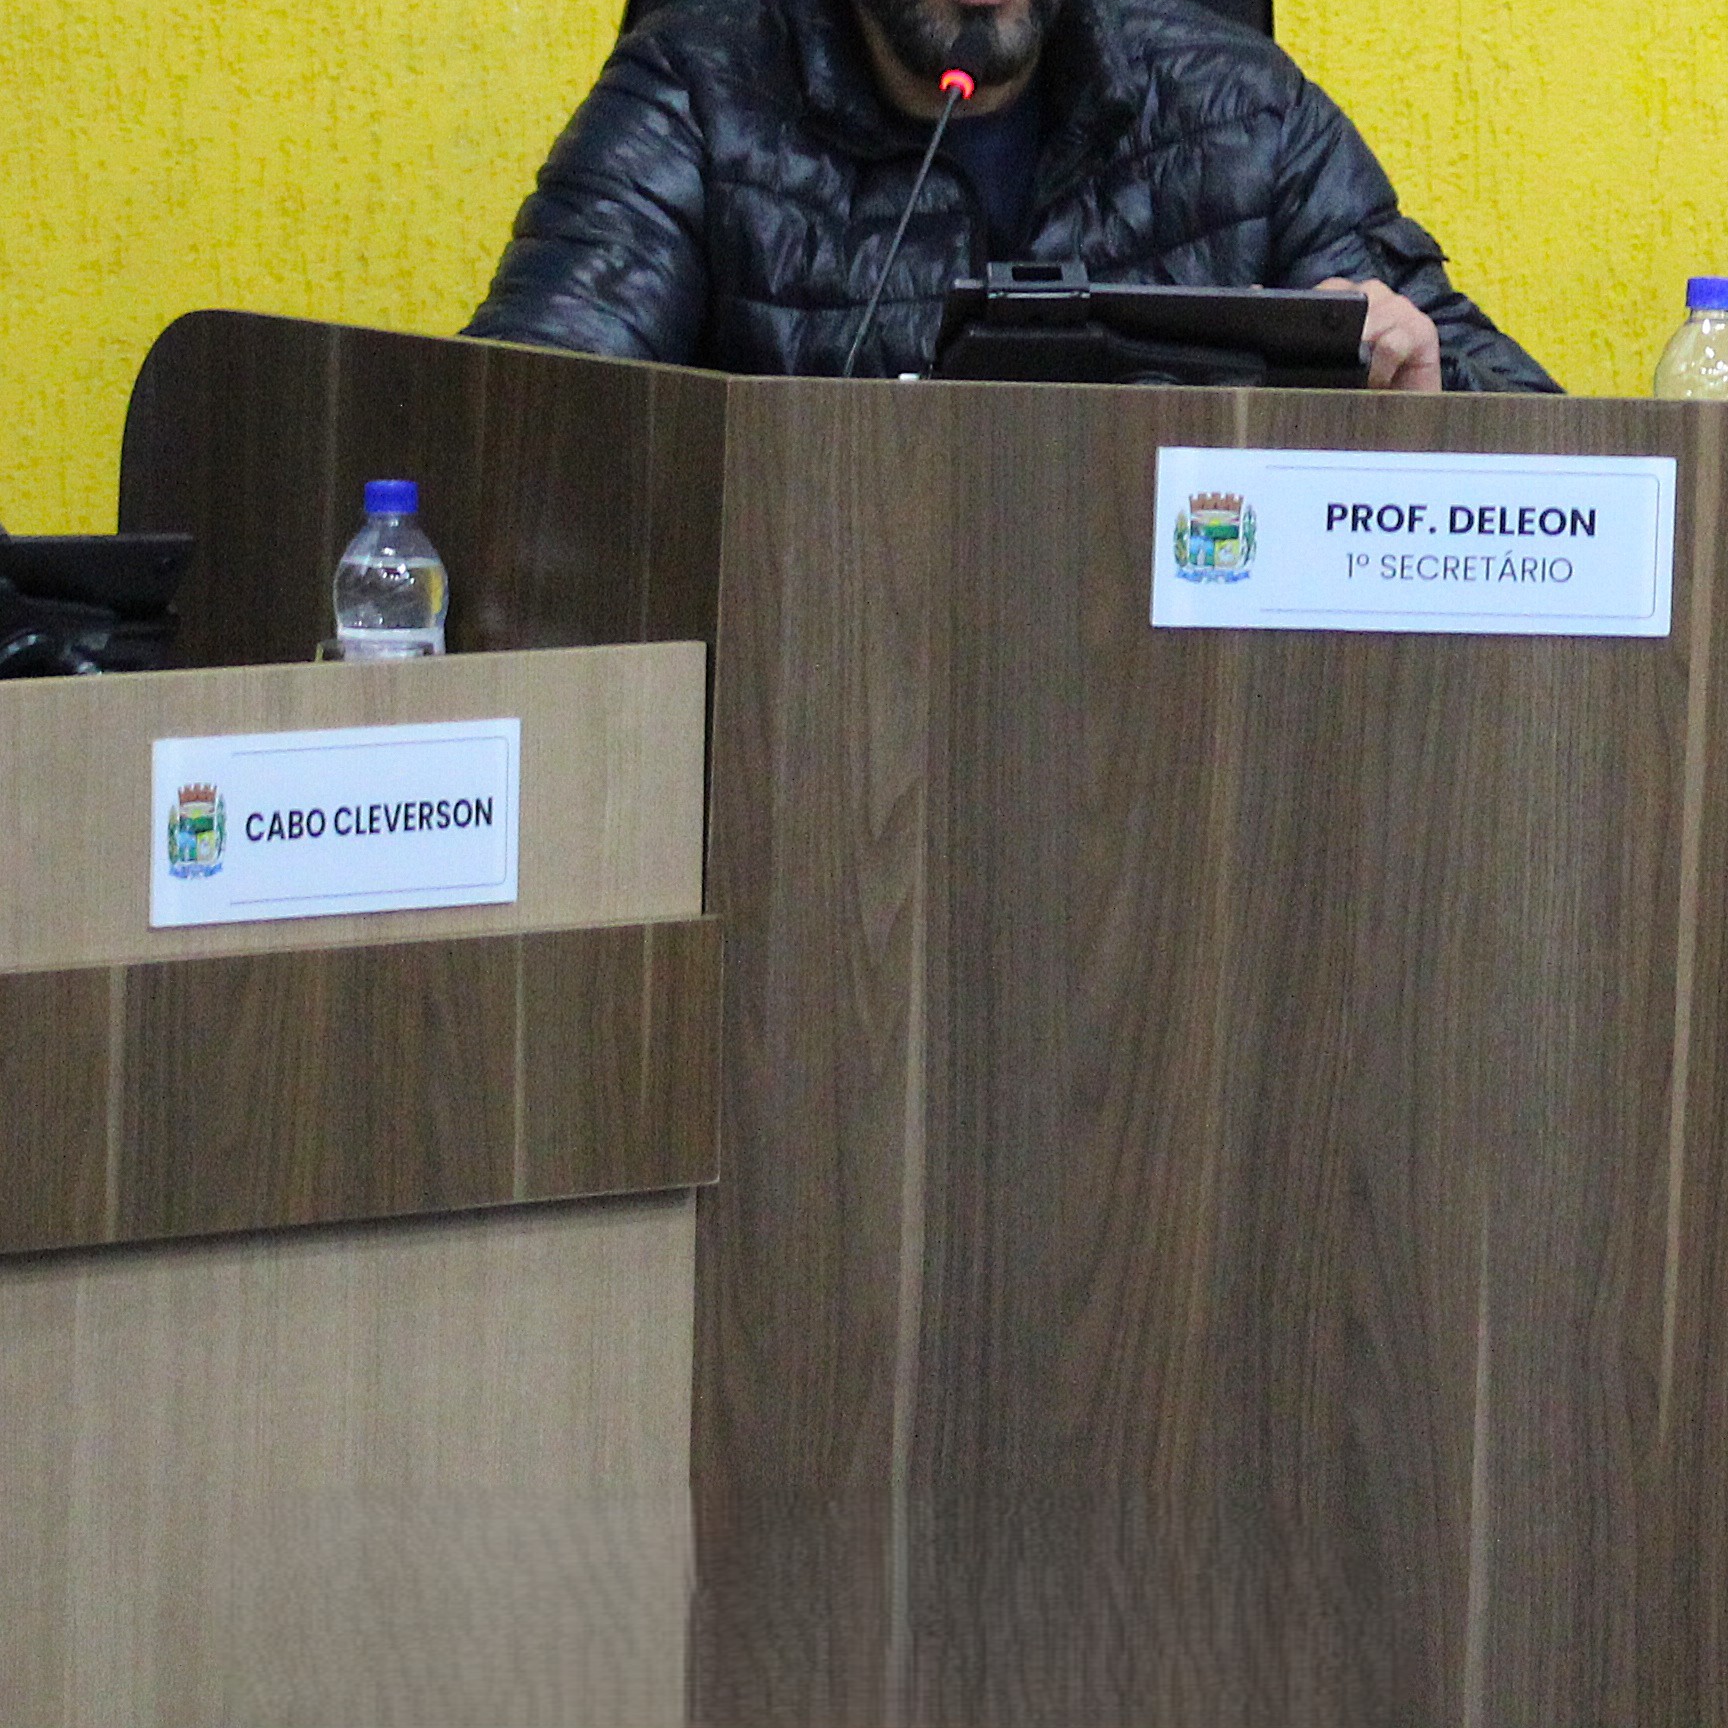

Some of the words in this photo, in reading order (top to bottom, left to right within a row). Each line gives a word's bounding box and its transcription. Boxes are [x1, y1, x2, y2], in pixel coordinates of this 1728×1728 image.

[1326, 503, 1437, 534] PROF.
[1449, 505, 1597, 536] DELEON
[1346, 552, 1370, 579] 1º
[1381, 550, 1574, 583] SECRETÁRIO
[245, 808, 326, 842] CABO
[333, 797, 494, 836] CLEVERSON
